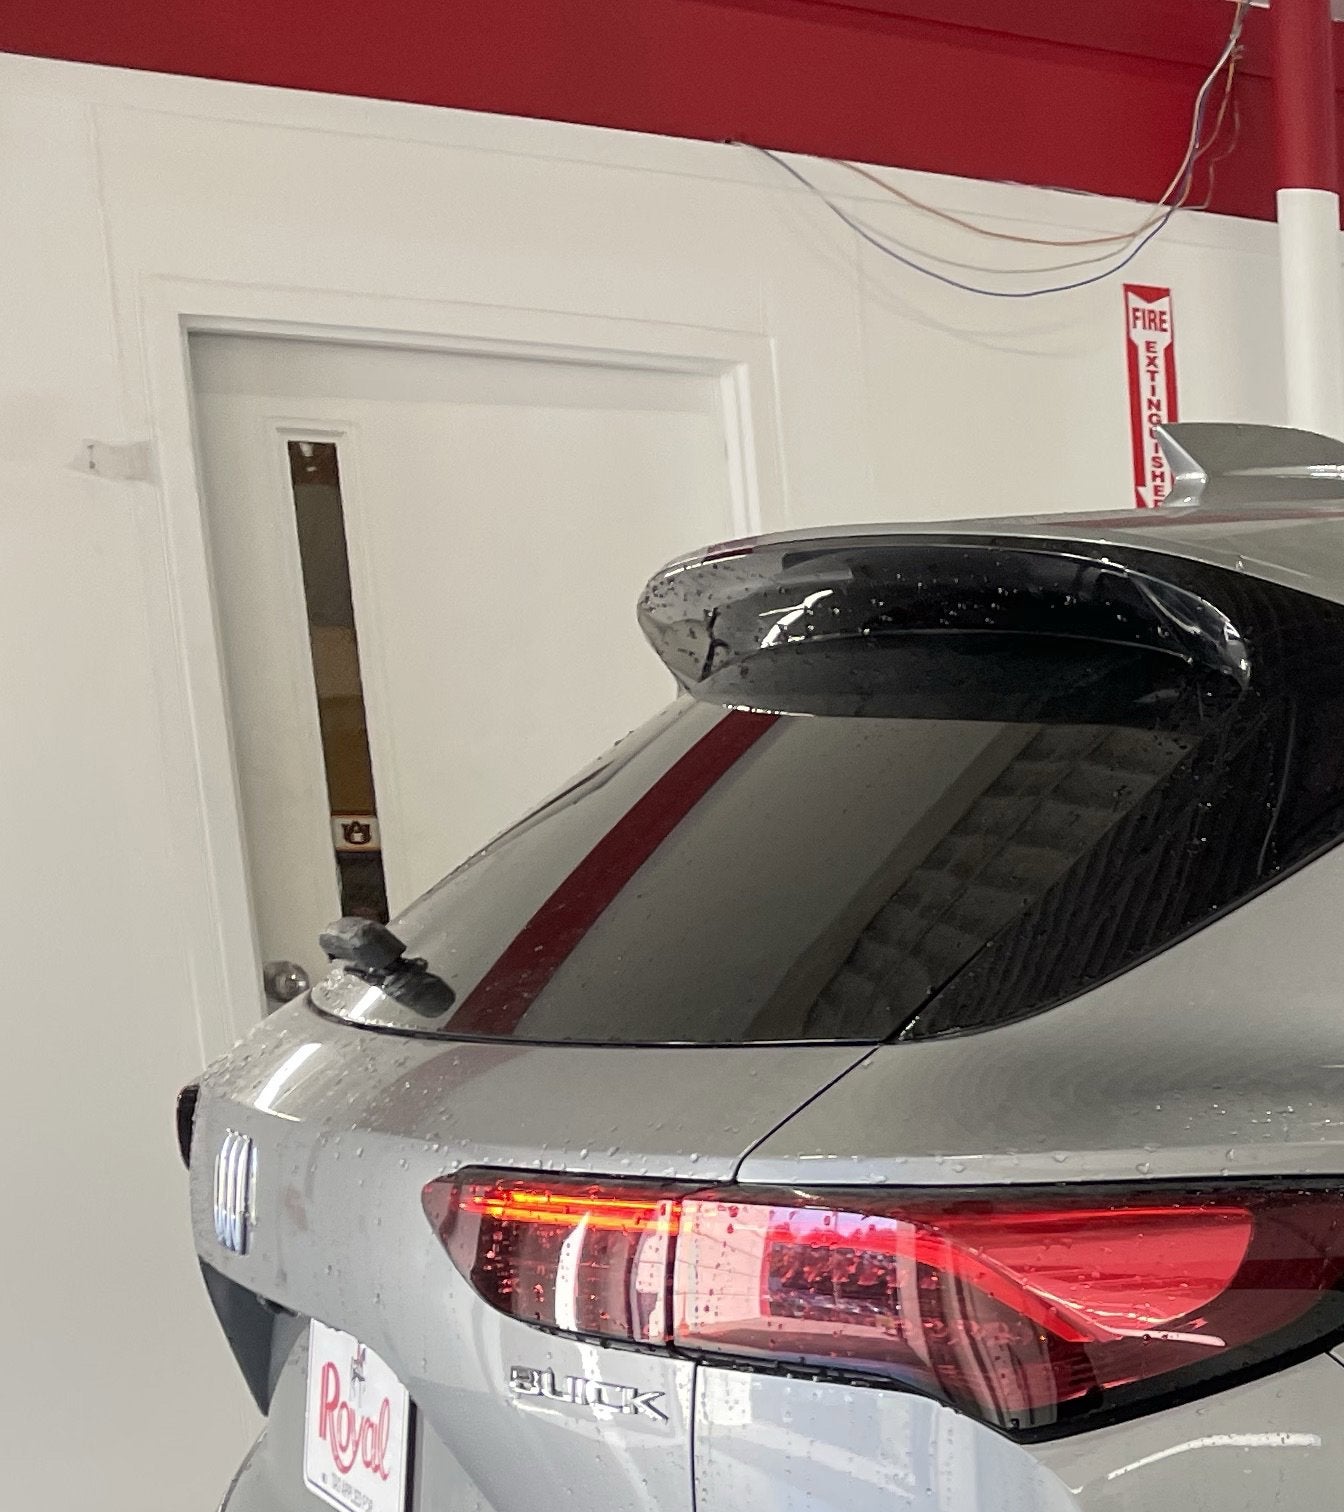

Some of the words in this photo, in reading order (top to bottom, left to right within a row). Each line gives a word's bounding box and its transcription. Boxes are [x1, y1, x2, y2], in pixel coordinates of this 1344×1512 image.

[1131, 307, 1168, 333] FIRE
[319, 1361, 391, 1481] Royal
[510, 1365, 669, 1425] BUICK
